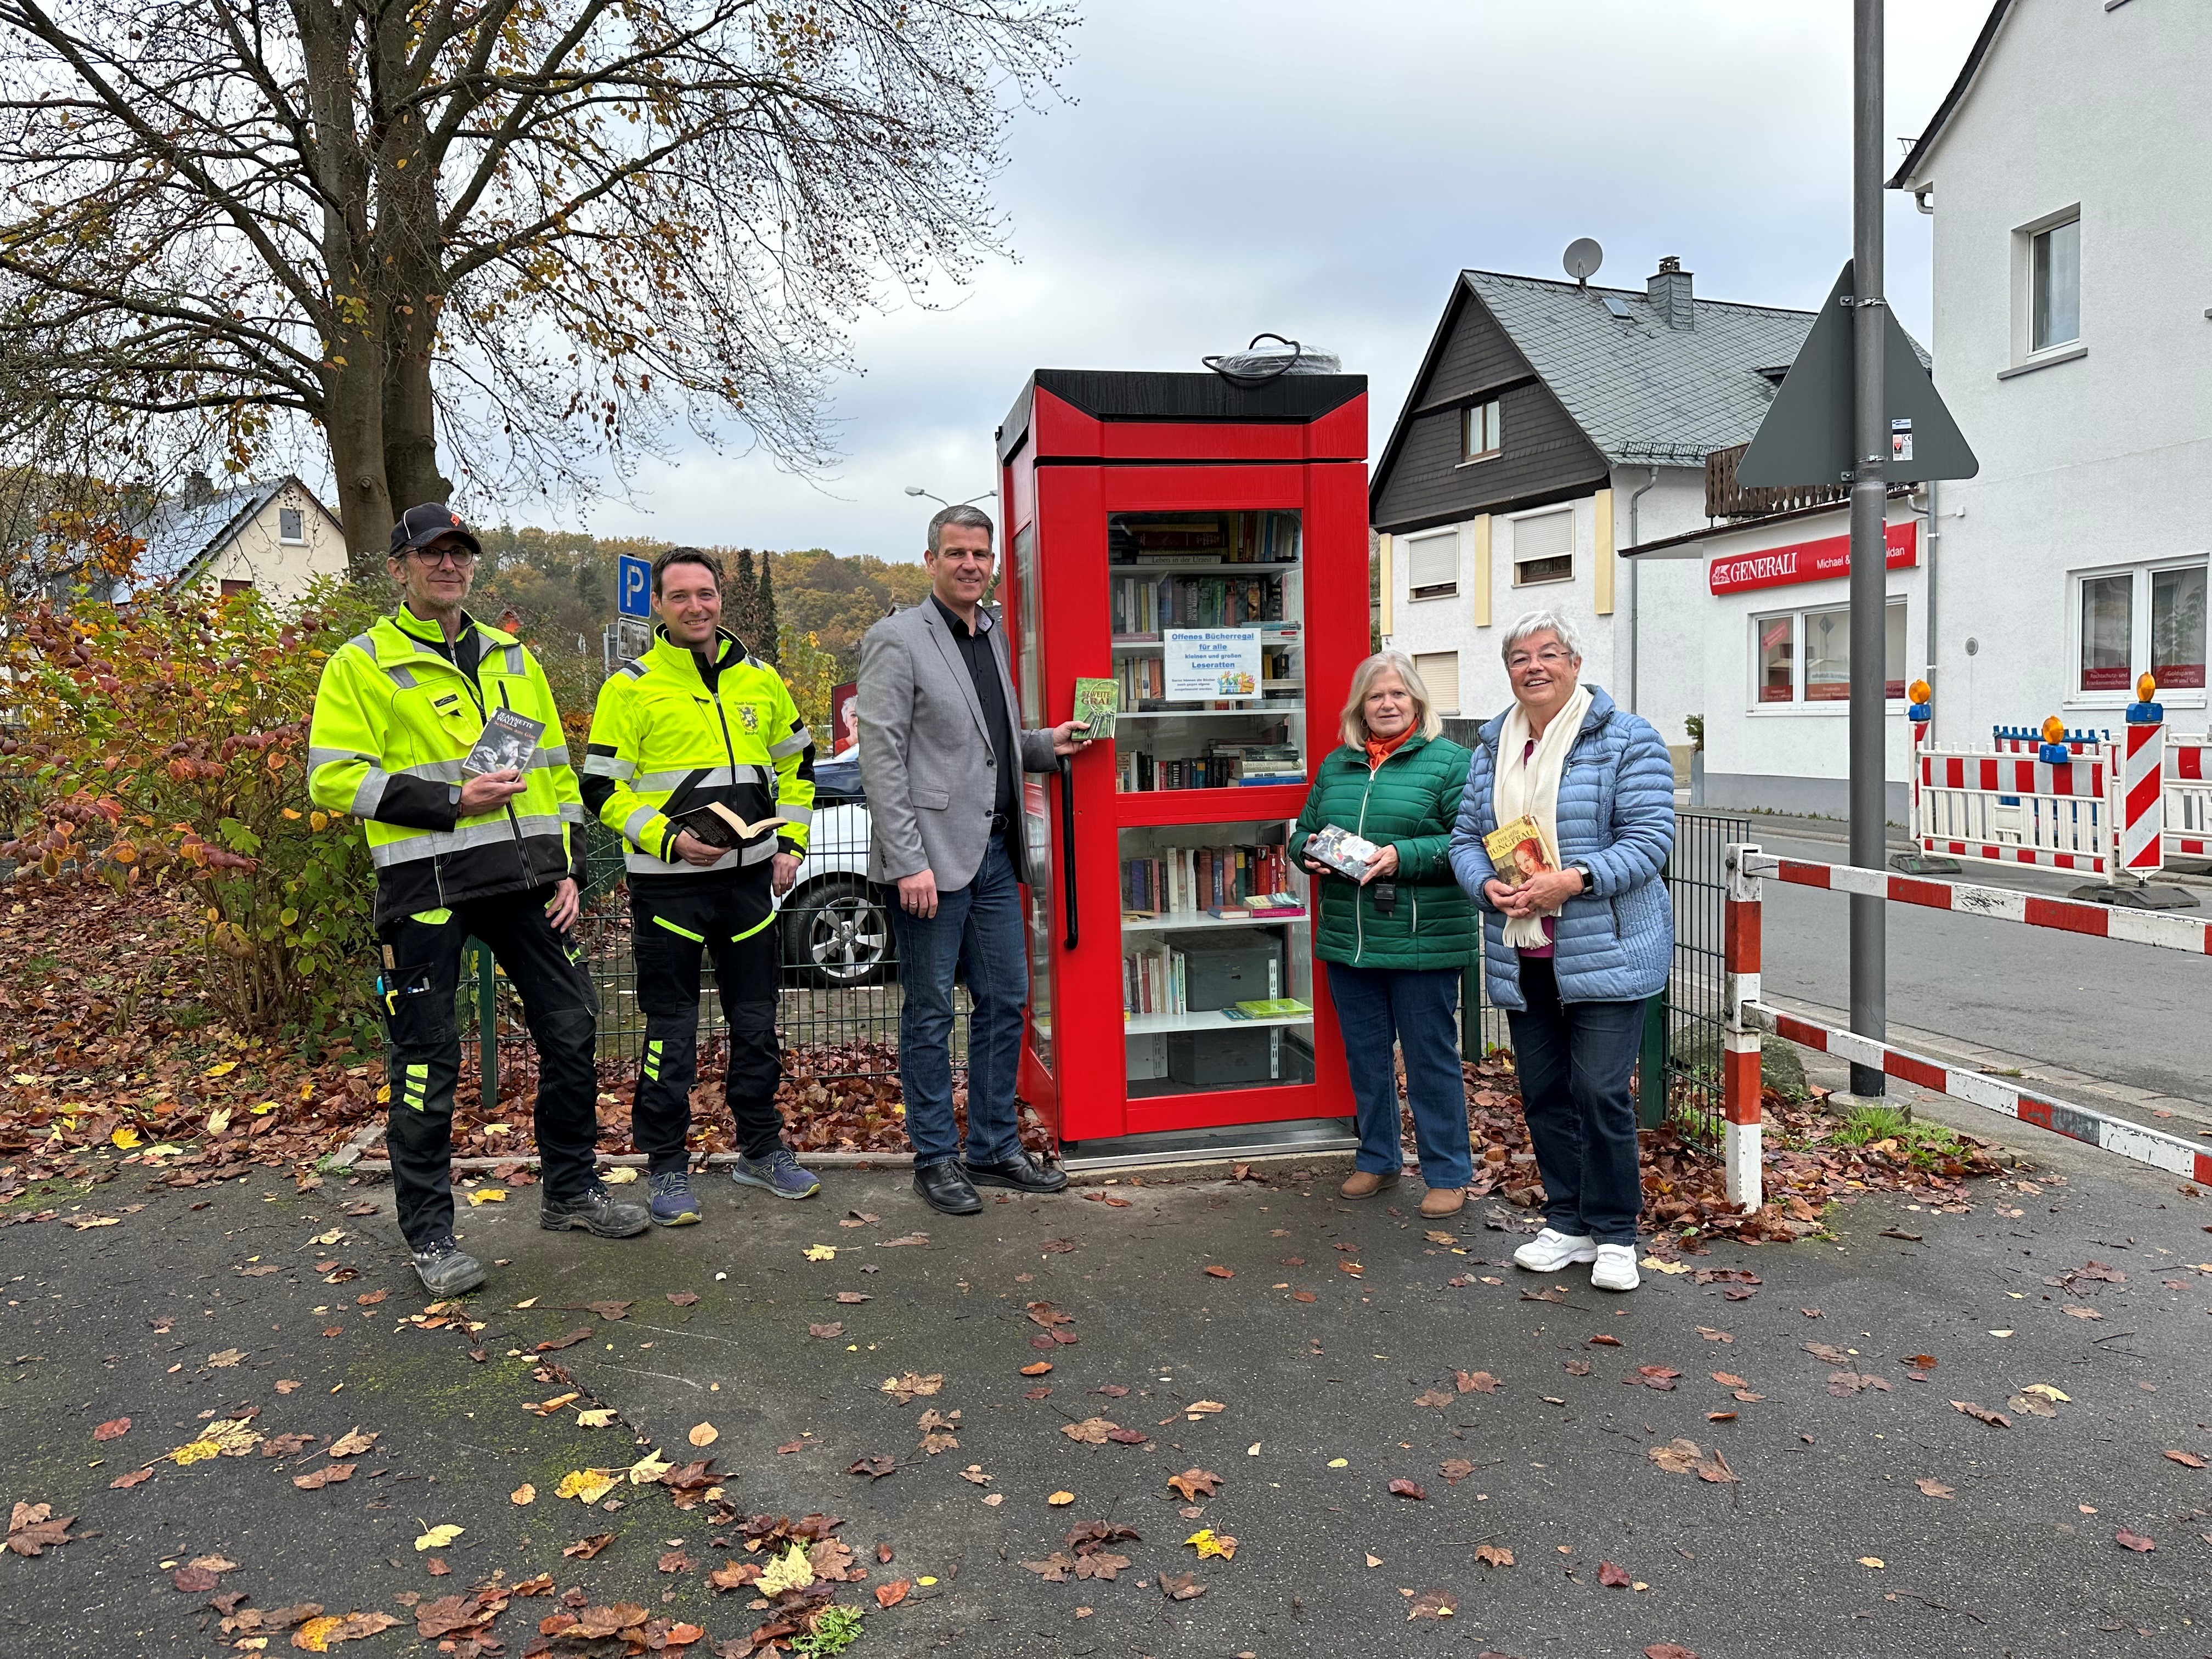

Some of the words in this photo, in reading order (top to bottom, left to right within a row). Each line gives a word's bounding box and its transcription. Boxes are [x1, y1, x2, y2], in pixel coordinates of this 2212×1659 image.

[1730, 552, 1797, 583] GENERALI
[1816, 555, 1843, 569] Michael
[627, 565, 644, 607] P
[1205, 633, 1254, 641] Bücherregal
[496, 714, 517, 727] WALLS
[499, 712, 534, 729] JEANNETTE
[1489, 830, 1505, 839] ANDREA
[1504, 820, 1522, 831] SCHACHT
[1497, 836, 1508, 844] DIE
[1508, 829, 1520, 839] elfte
[1489, 828, 1533, 857] JUNGFRAU
